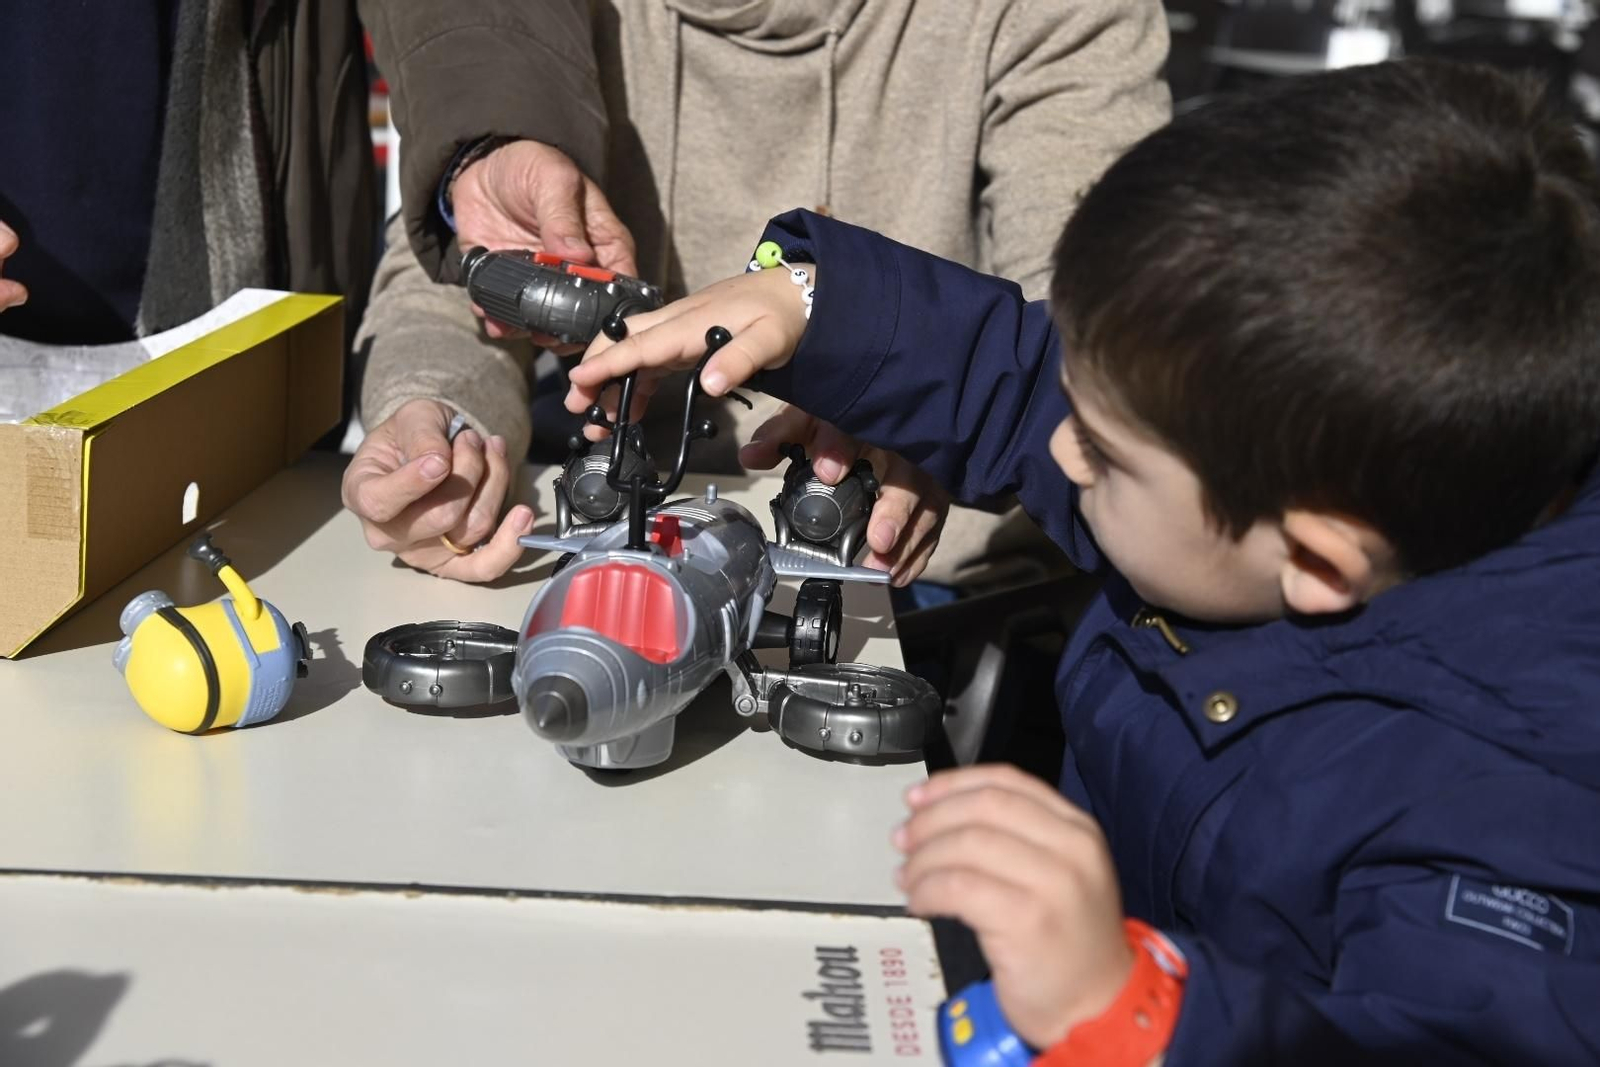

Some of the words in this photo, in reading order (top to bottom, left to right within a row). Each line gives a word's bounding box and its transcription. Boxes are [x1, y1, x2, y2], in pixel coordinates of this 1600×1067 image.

[879, 947, 908, 986] 1890
[802, 945, 872, 1054] Mahou
[887, 995, 922, 1056] DESDE
